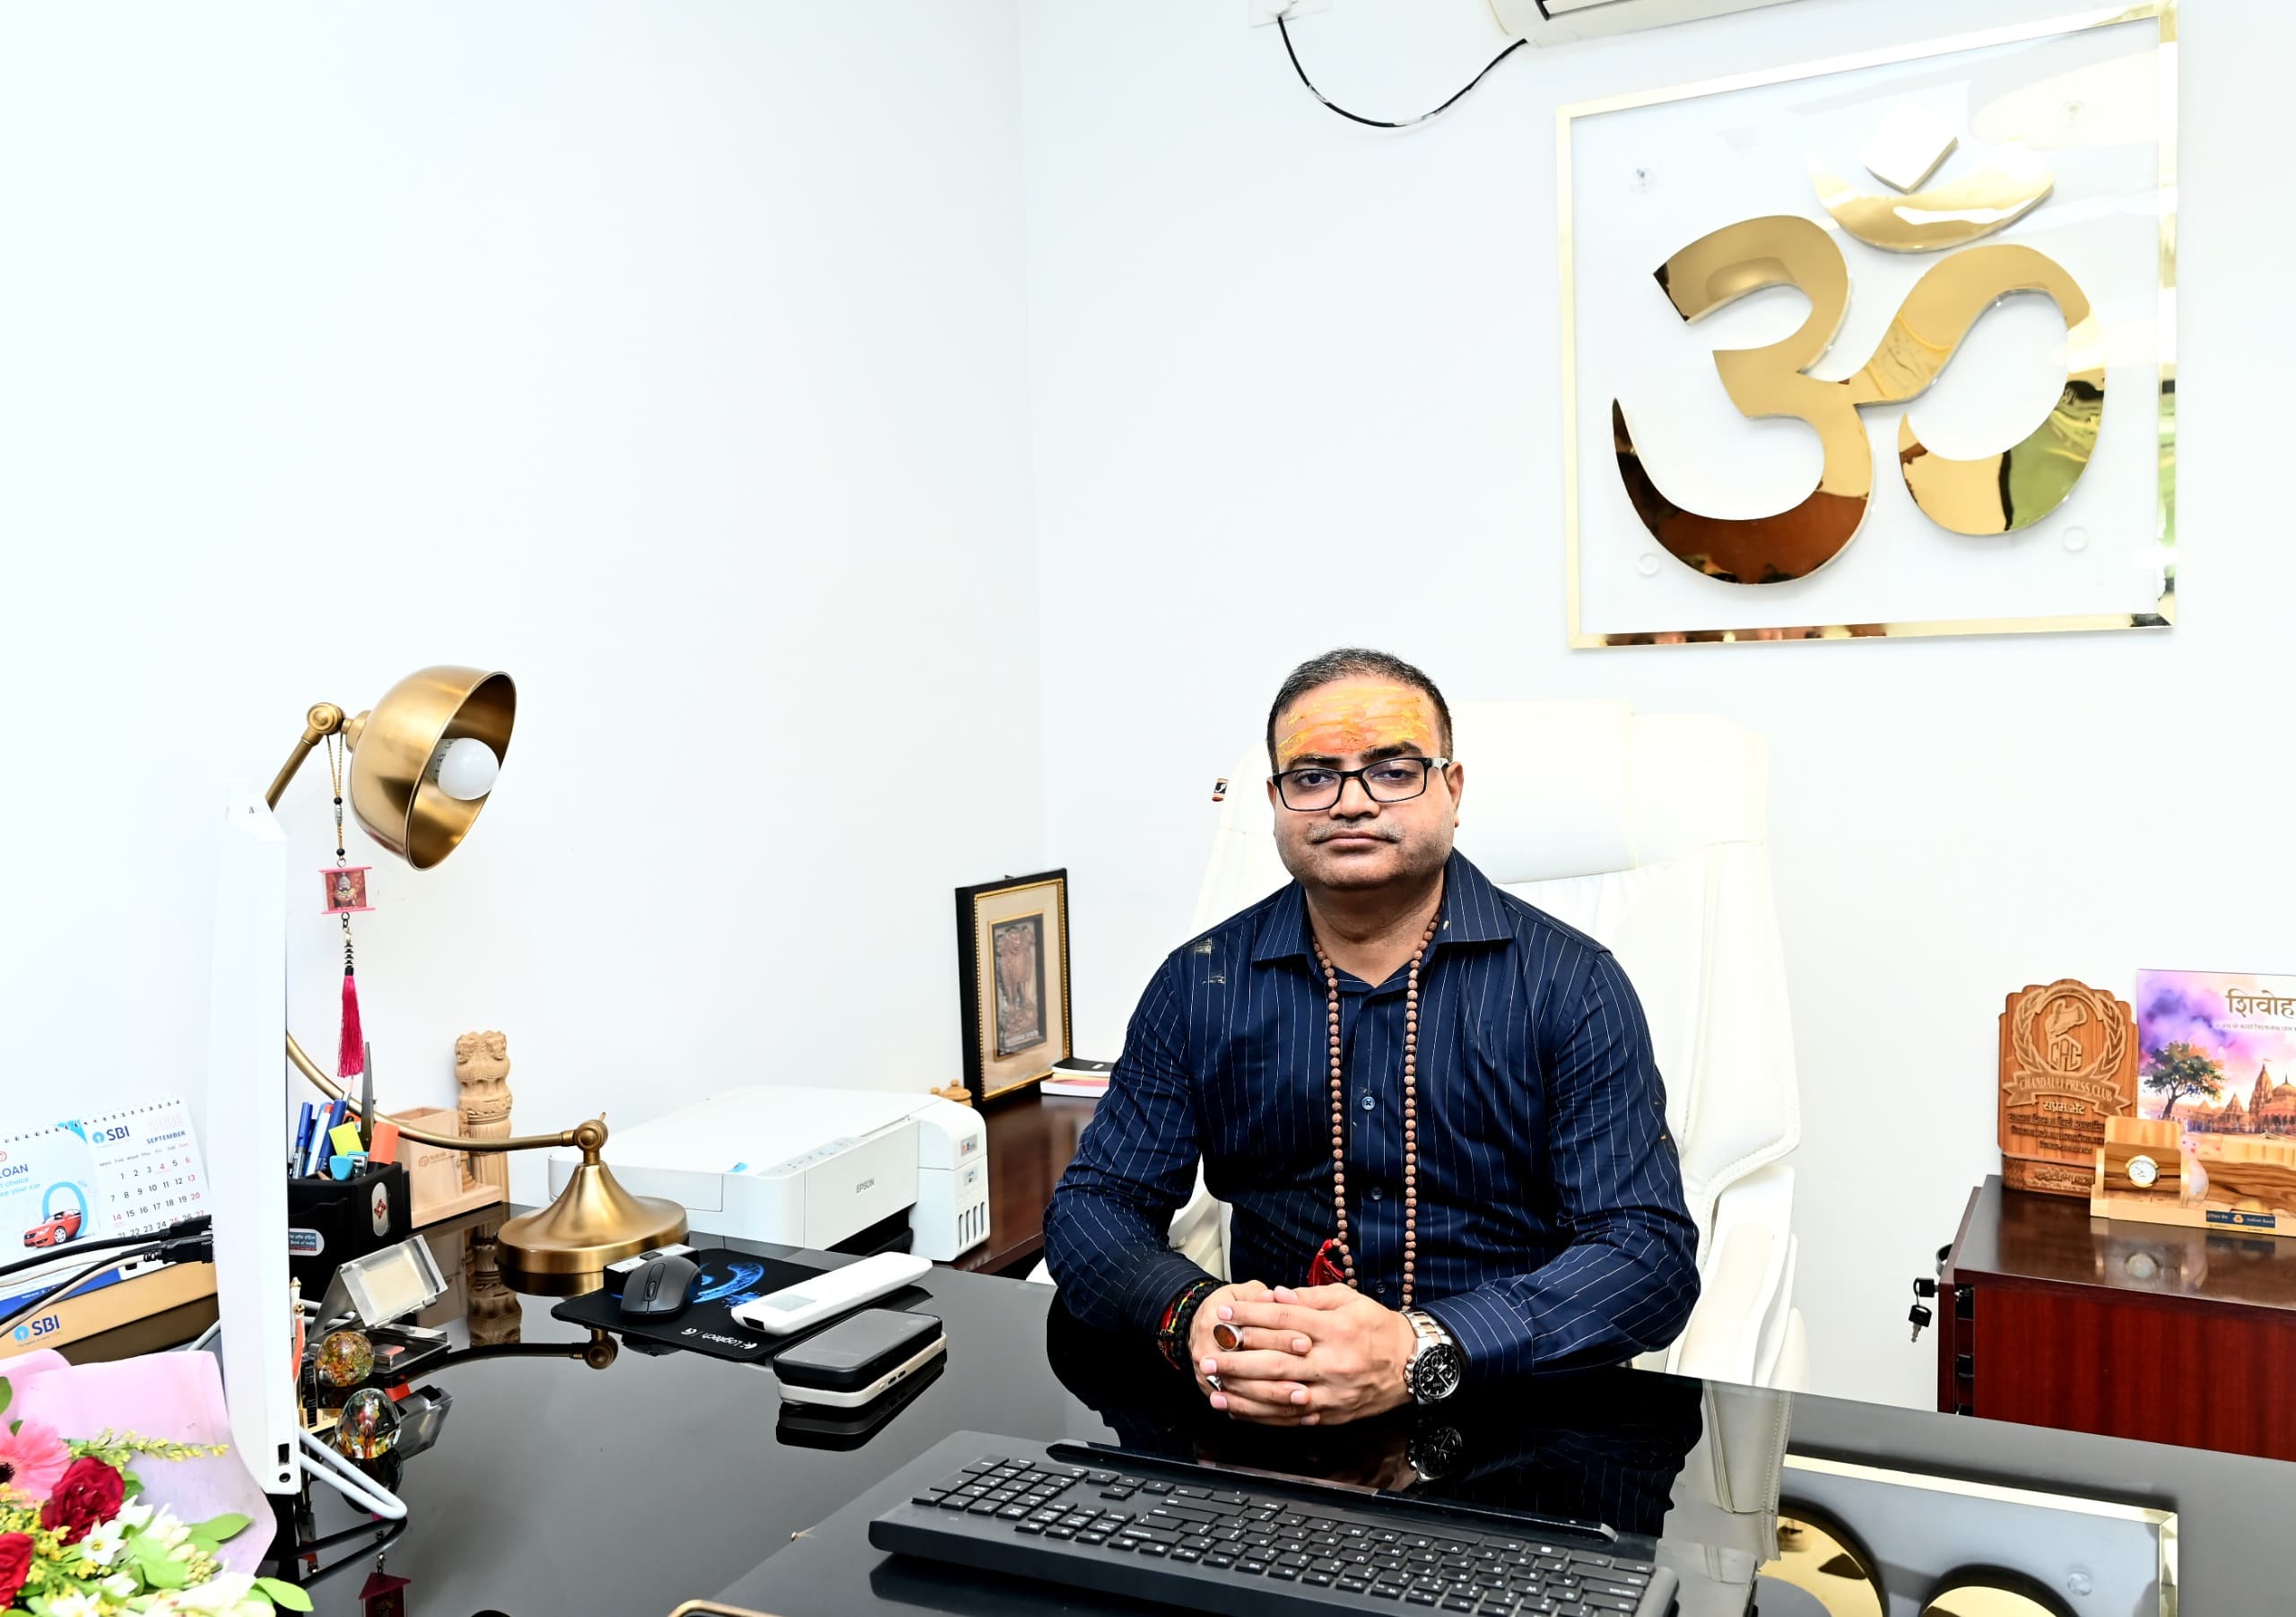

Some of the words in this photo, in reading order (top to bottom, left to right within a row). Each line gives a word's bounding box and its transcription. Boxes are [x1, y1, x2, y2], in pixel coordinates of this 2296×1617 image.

[2019, 1076, 2064, 1091] CHANDAULI
[2066, 1078, 2091, 1093] PRESS
[2092, 1084, 2113, 1102] CLUB
[106, 1126, 130, 1142] SBI
[146, 1130, 187, 1144] SEPTEMBER
[149, 1184, 157, 1192] 10
[175, 1178, 183, 1186] 12
[187, 1174, 196, 1182] 13
[856, 1178, 875, 1194] EPSON
[113, 1213, 122, 1221] 14
[126, 1209, 135, 1218] 15
[139, 1205, 148, 1214] 16
[153, 1203, 161, 1211] 17
[166, 1199, 174, 1207] 18
[178, 1195, 187, 1204] 19
[191, 1192, 200, 1200] 20
[144, 1224, 153, 1232] 23
[156, 1221, 167, 1229] 24
[31, 1314, 60, 1336] SBI
[701, 1333, 744, 1346] Logitech
